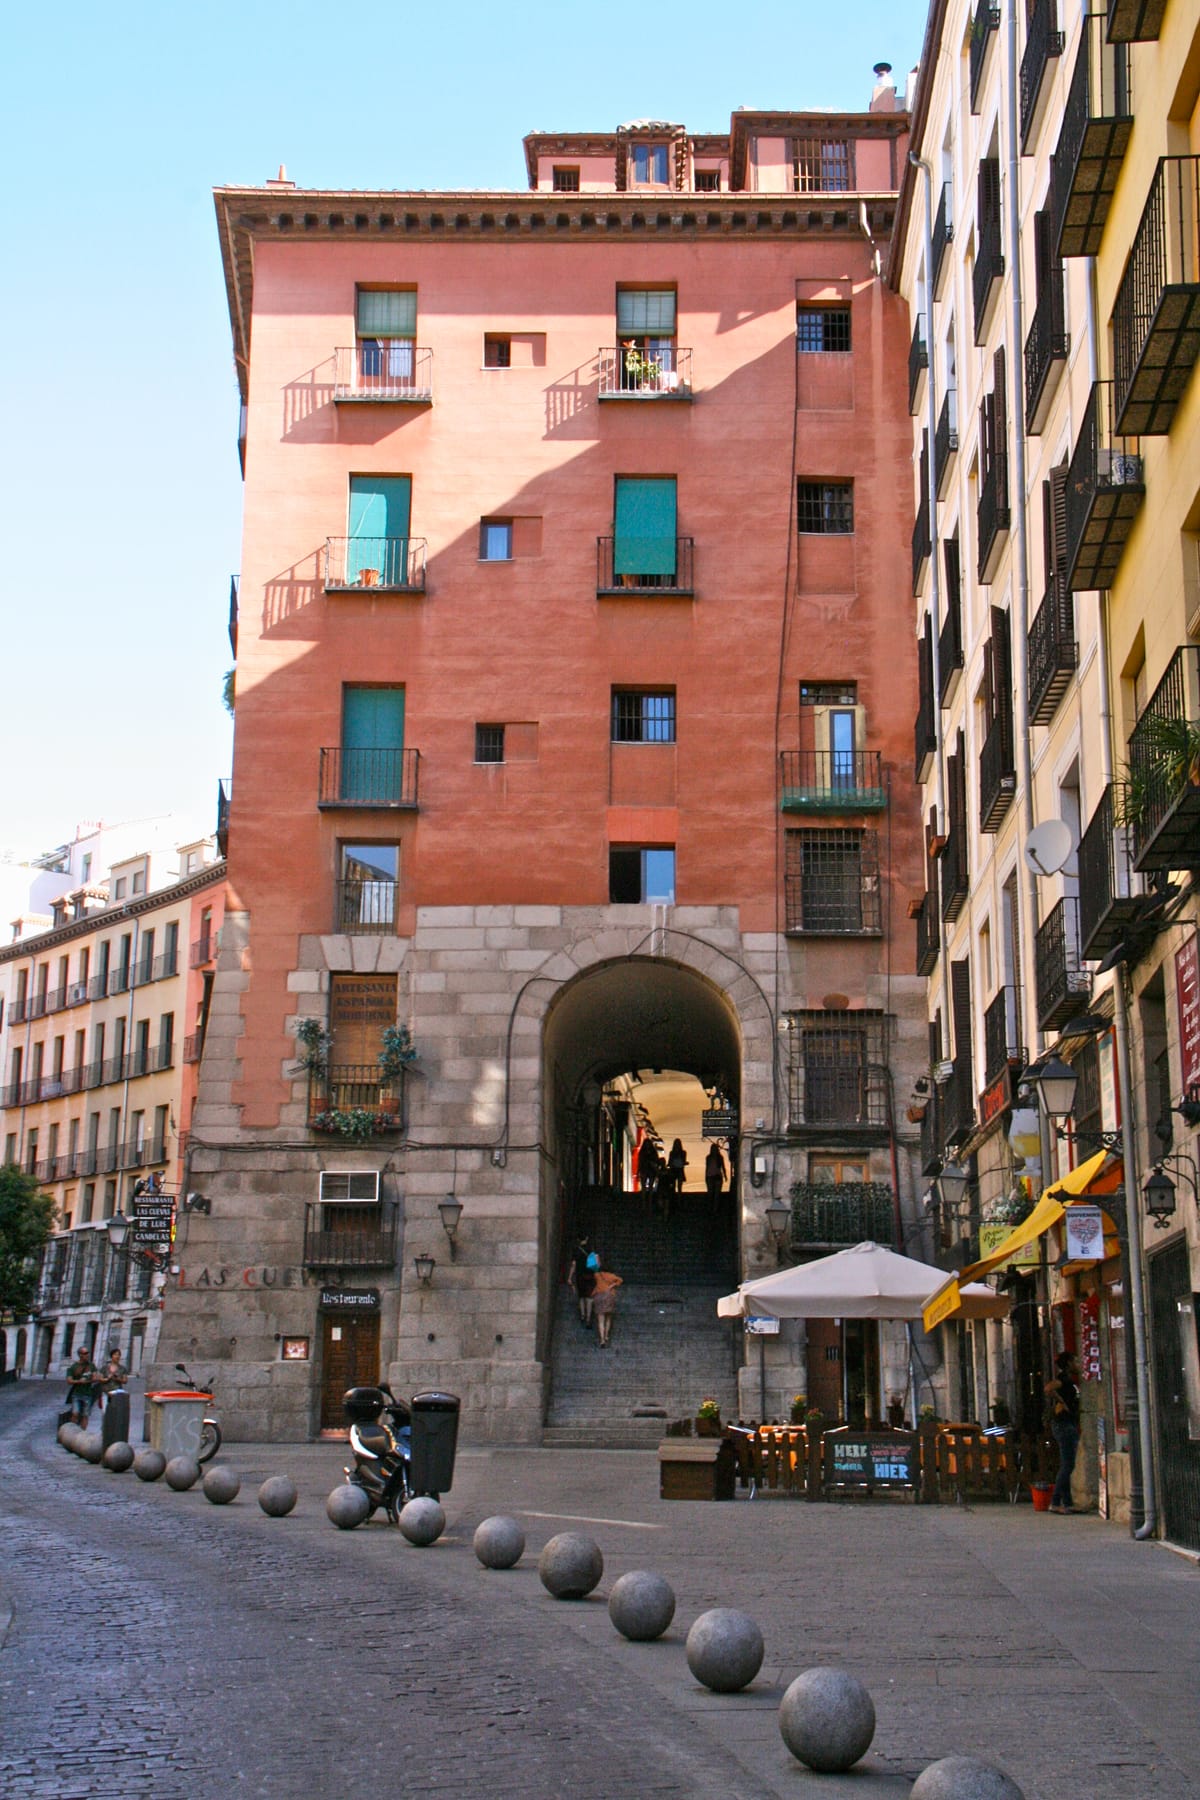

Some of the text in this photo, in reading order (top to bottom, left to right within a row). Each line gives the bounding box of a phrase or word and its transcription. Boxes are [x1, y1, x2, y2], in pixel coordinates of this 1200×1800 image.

[136, 1208, 171, 1216] LAS CUEVAS
[139, 1220, 167, 1228] DE LUIS
[178, 1267, 345, 1287] LAS CUEVAS
[834, 1444, 868, 1458] HERE
[874, 1463, 909, 1479] HIER
